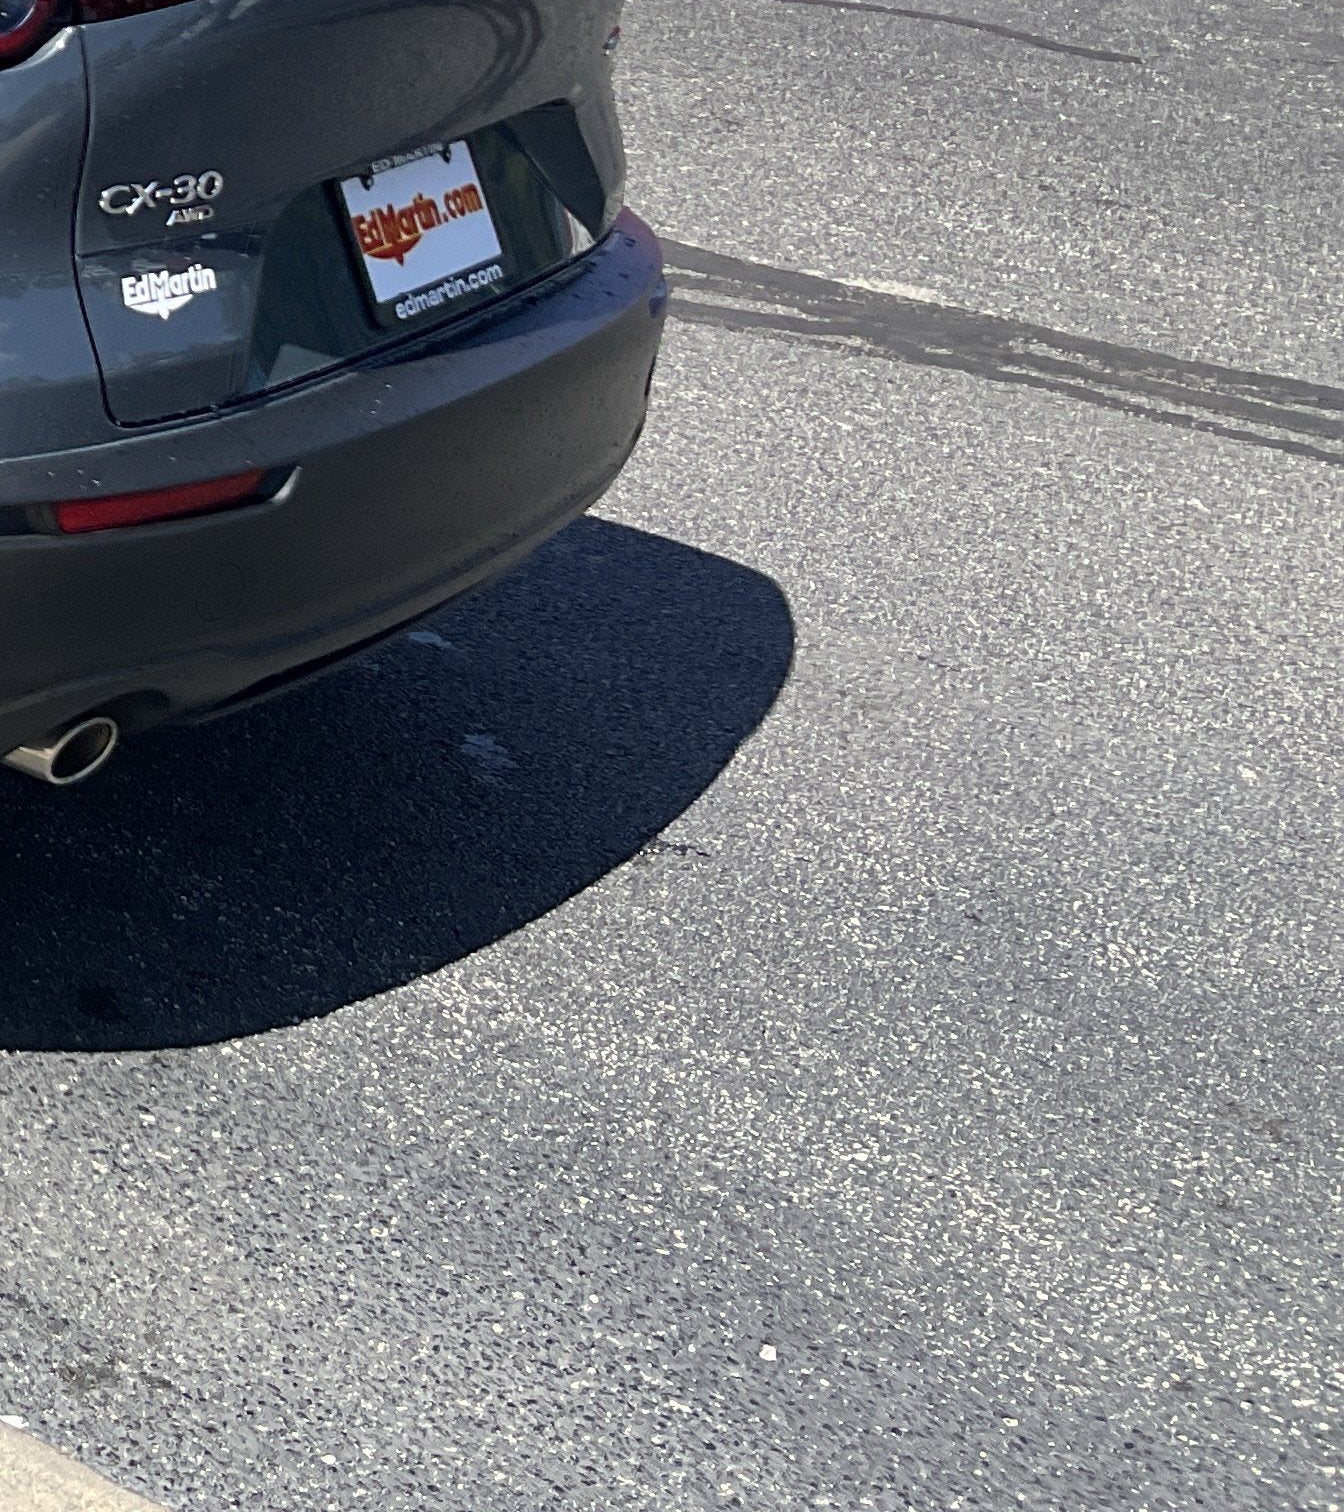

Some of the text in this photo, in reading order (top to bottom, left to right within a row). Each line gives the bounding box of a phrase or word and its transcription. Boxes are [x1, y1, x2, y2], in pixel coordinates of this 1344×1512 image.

[99, 170, 223, 214] CX-30
[166, 204, 214, 226] AWD
[395, 263, 503, 319] edmartin.com
